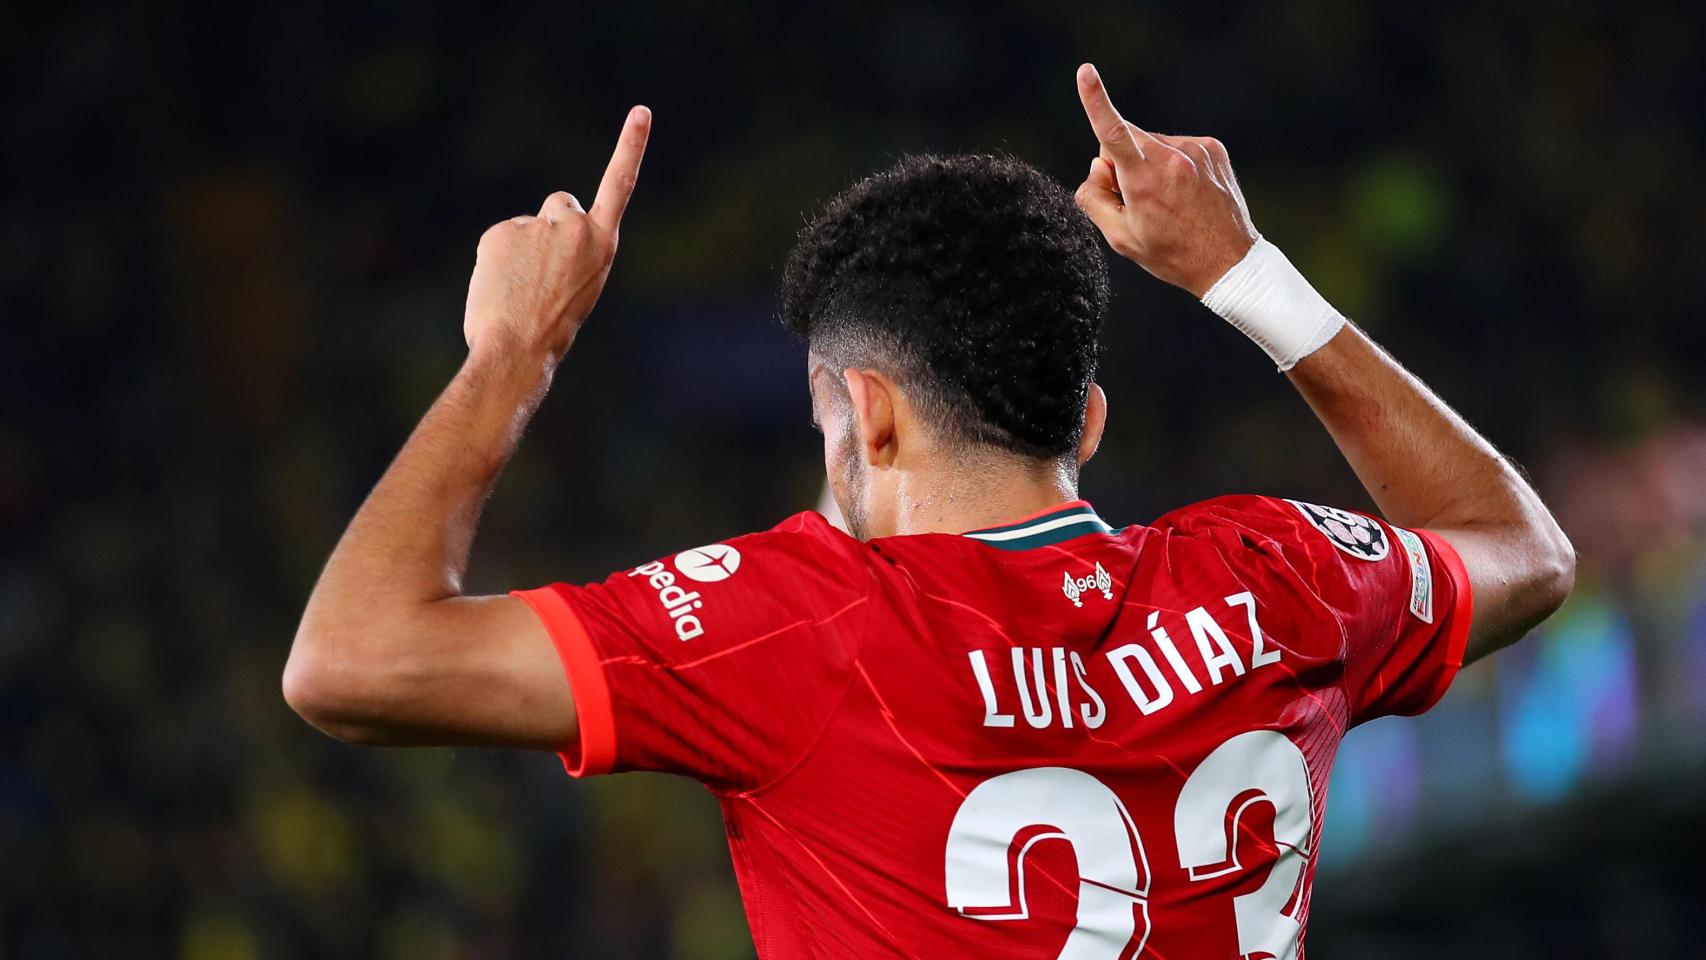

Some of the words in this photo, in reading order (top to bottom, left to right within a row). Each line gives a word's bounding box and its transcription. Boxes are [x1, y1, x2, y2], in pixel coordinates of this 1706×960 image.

[1076, 574, 1097, 593] 96
[967, 646, 1107, 730] LUIS
[1105, 591, 1281, 717] DÍAZ
[945, 729, 1314, 960] 23
